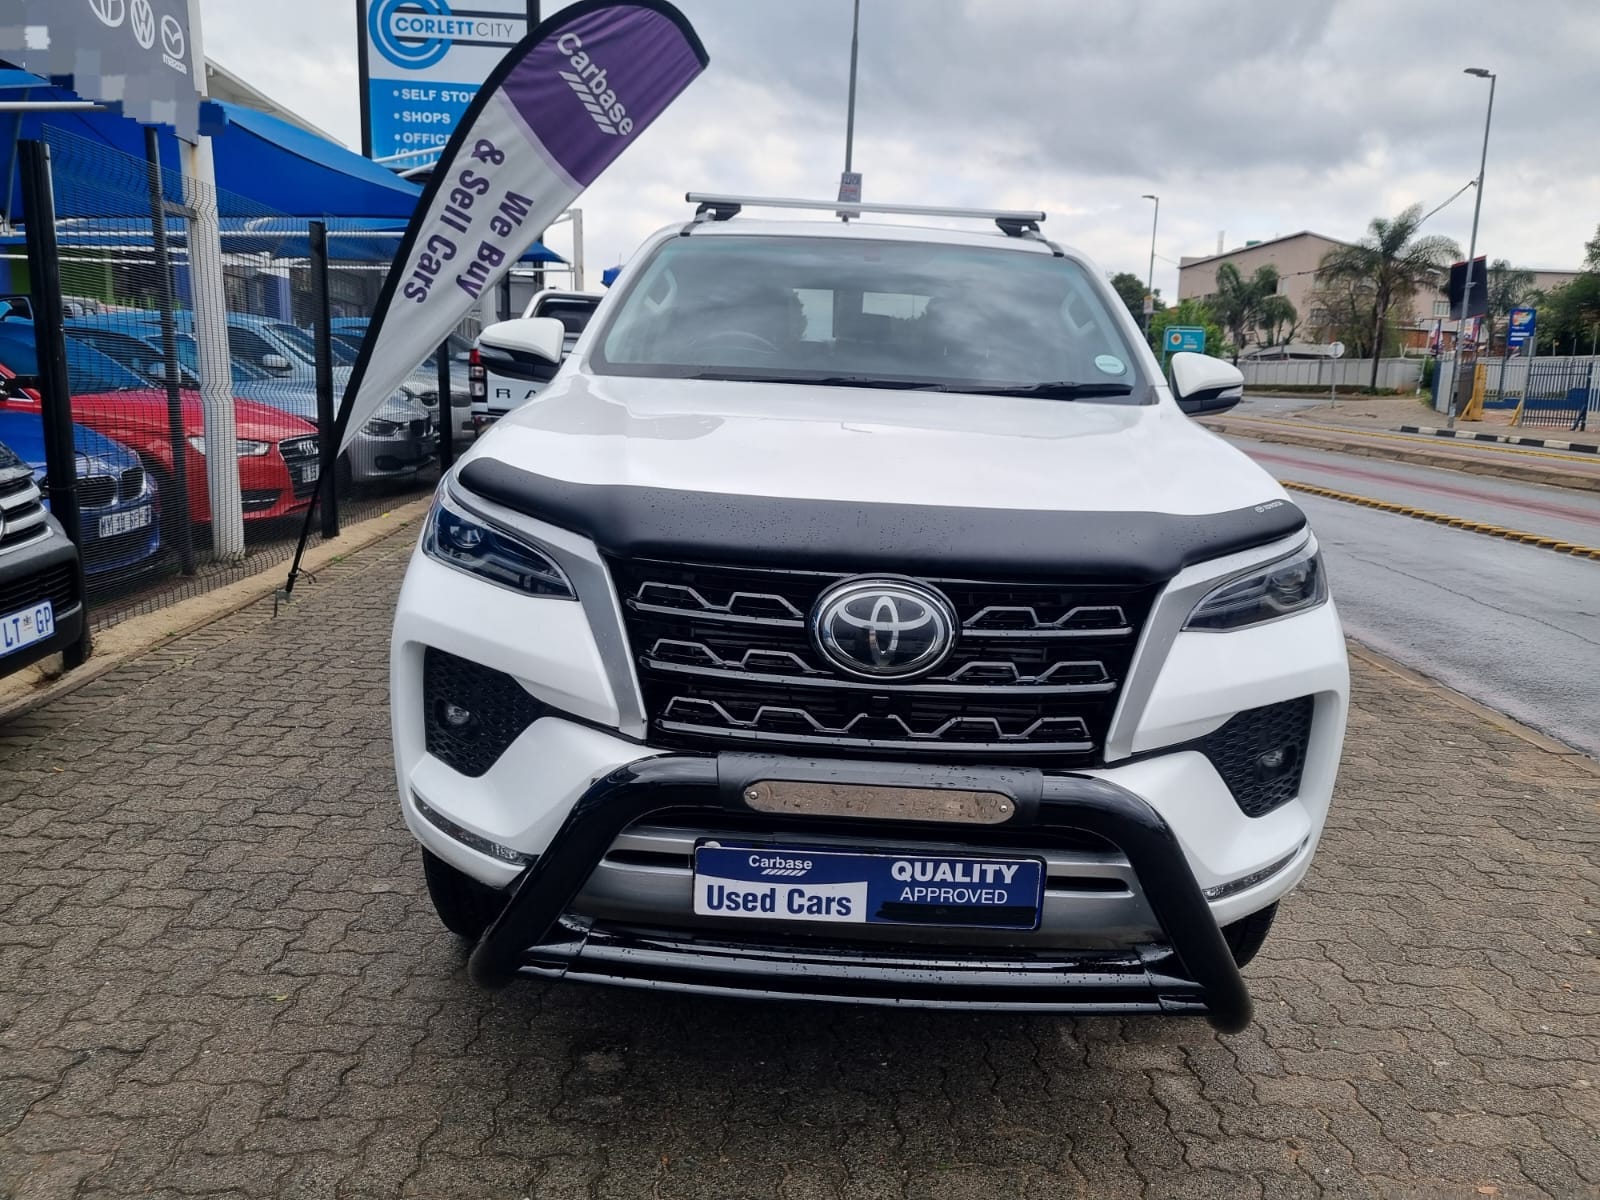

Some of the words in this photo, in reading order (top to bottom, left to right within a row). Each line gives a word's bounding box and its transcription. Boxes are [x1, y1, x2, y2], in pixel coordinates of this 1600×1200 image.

[401, 88, 437, 100] SELF
[557, 33, 633, 135] Carbase
[402, 111, 451, 124] SHOPS
[471, 139, 505, 165] &
[440, 169, 490, 234] Sell
[490, 190, 534, 238] We
[403, 234, 457, 303] Cars
[456, 240, 506, 300] Buy
[35, 606, 51, 634] GP
[748, 855, 813, 870] Carbase
[891, 861, 1019, 884] QUALITY
[706, 884, 777, 913] Used
[786, 888, 852, 916] Cars
[900, 886, 1008, 904] APPROVED
